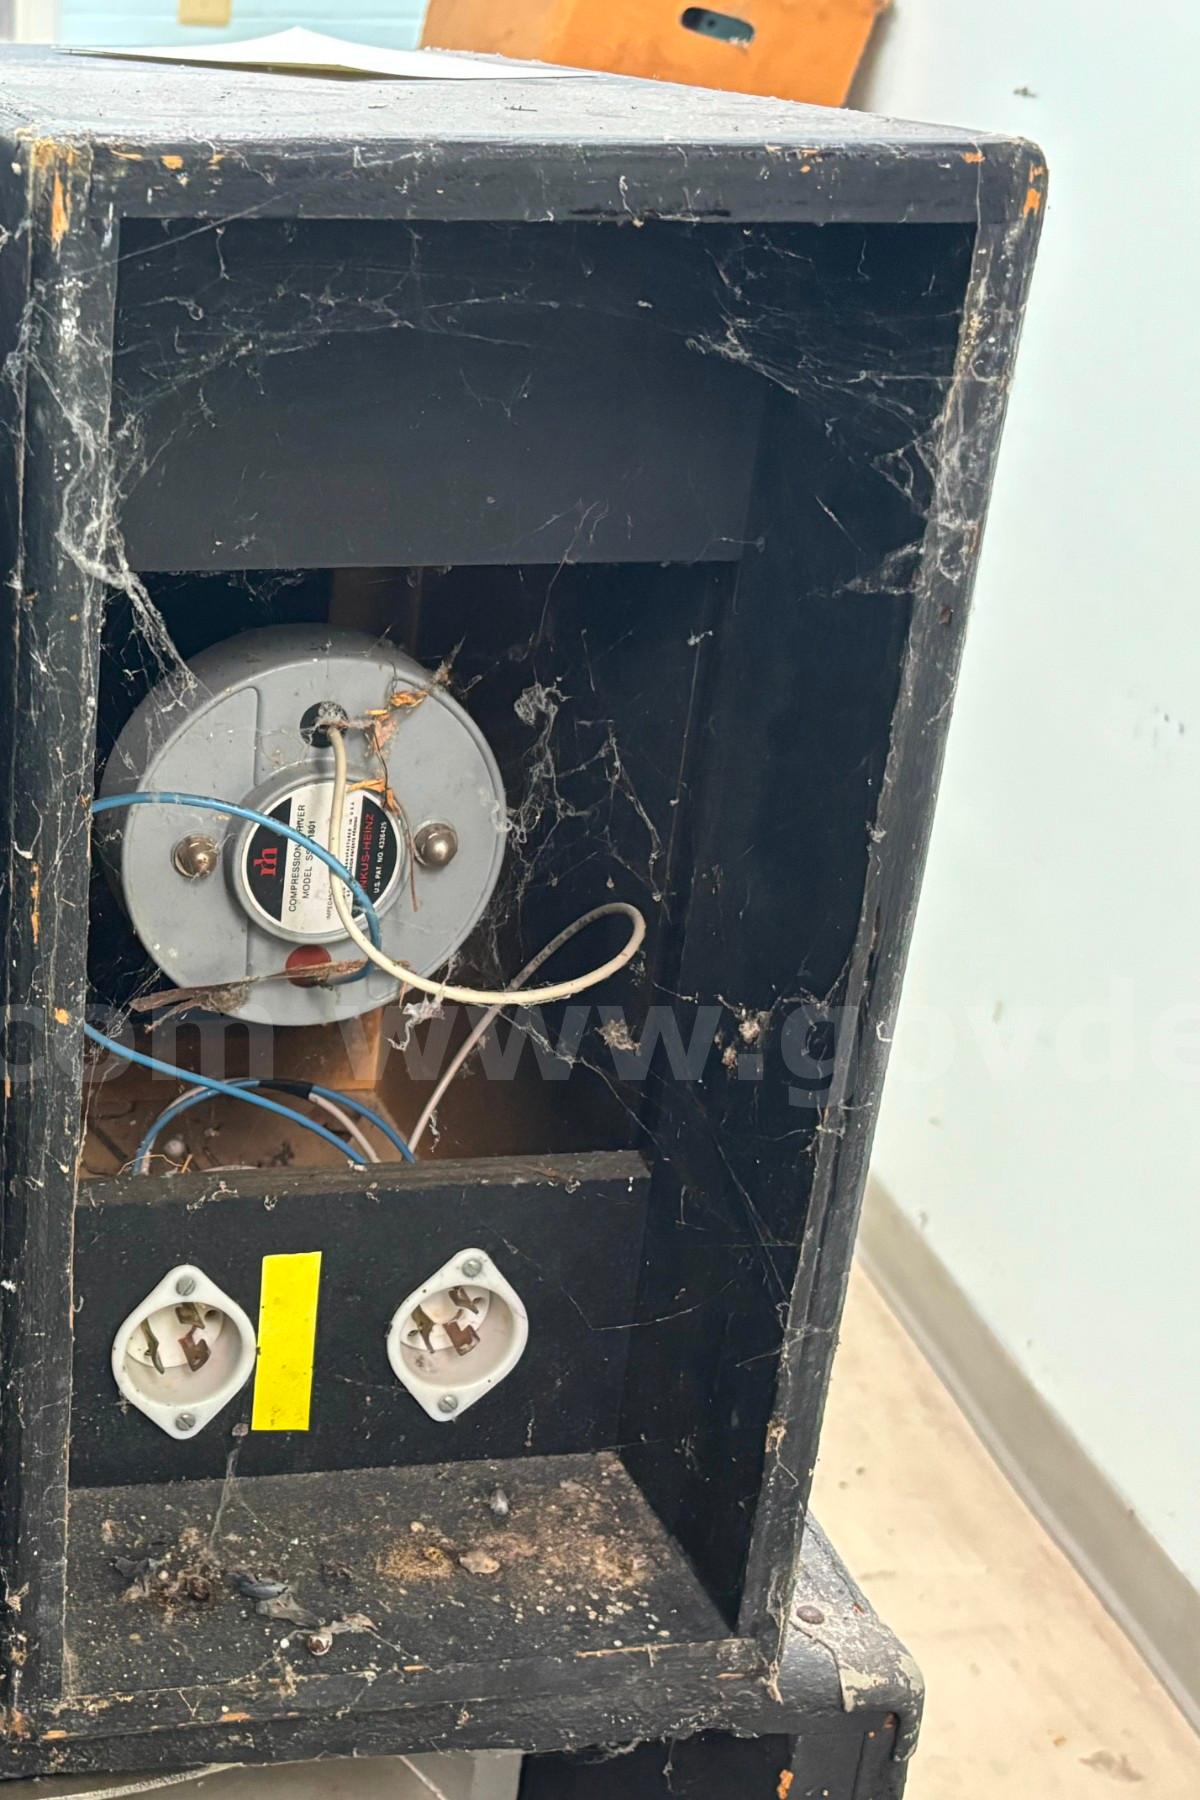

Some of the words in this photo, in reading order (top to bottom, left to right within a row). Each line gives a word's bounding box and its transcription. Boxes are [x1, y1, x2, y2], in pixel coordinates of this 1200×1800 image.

[295, 804, 306, 834] RIVER
[307, 820, 317, 838] 1801
[359, 813, 374, 889] NKUS-HEINZ
[288, 845, 303, 912] COMPRESSION
[302, 867, 313, 899] MODEL
